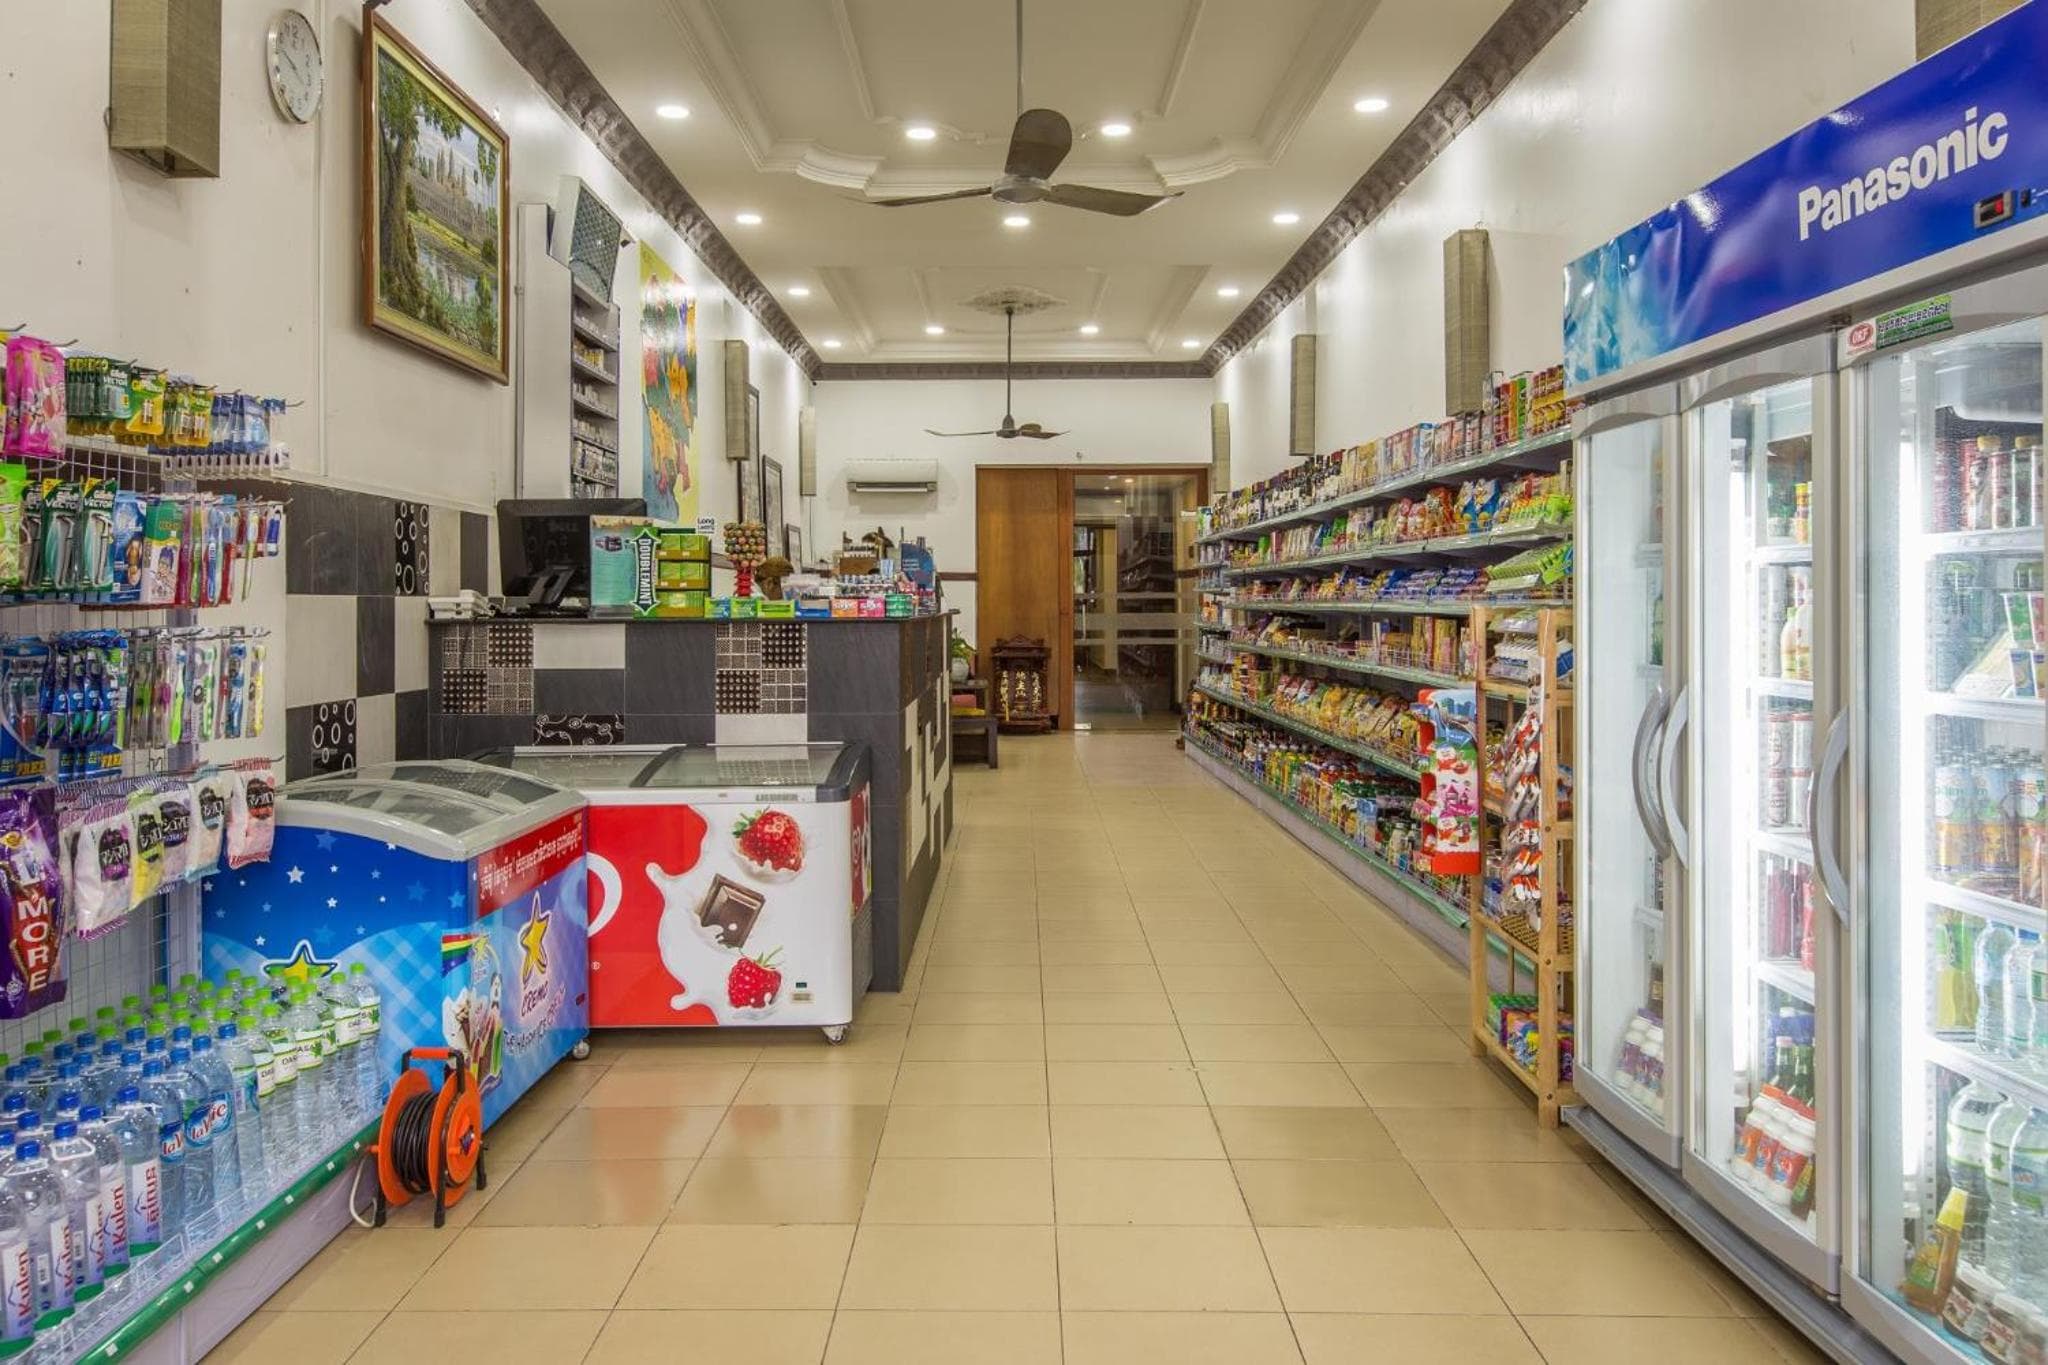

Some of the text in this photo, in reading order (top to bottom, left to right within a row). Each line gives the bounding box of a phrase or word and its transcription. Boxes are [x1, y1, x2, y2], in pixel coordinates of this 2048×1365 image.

[1798, 105, 2009, 241] Panasonic
[638, 538, 652, 605] DOUBLEMINT
[17, 898, 51, 993] MORE
[110, 1183, 127, 1246] Kulen
[16, 1250, 32, 1317] Kulen
